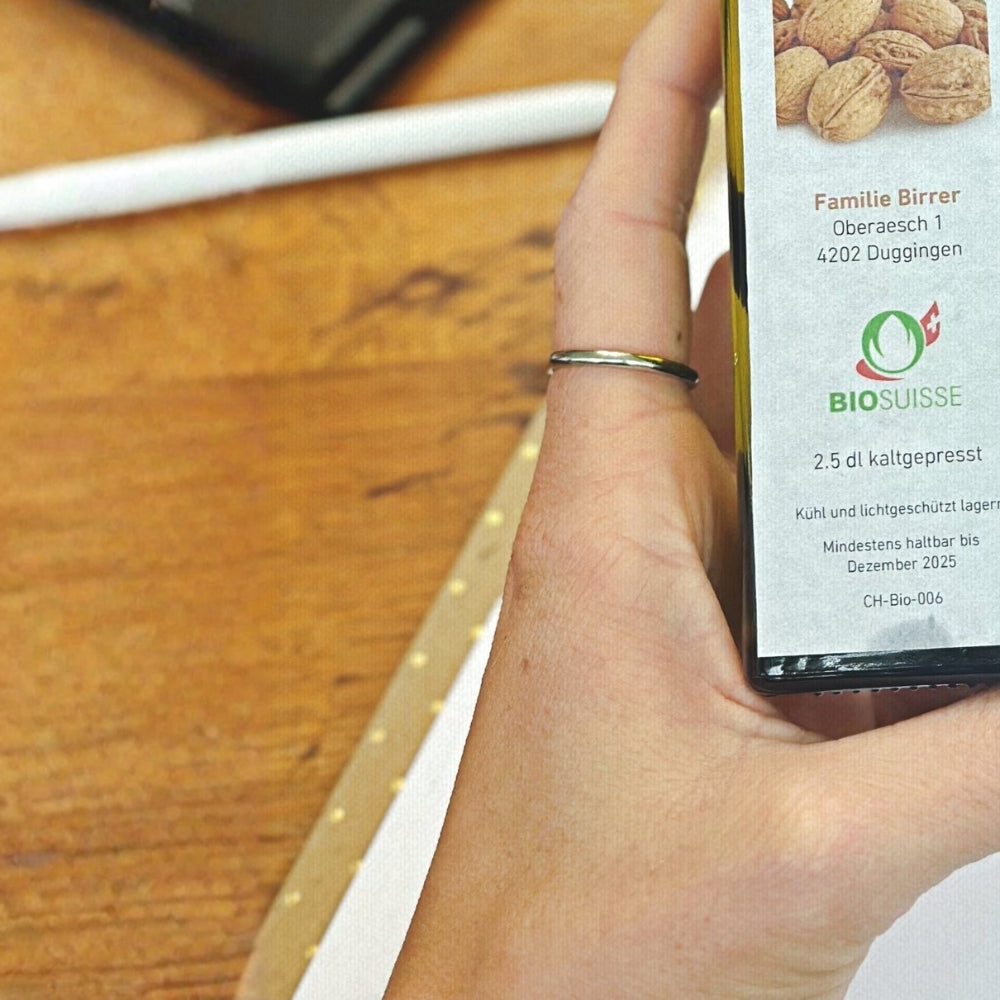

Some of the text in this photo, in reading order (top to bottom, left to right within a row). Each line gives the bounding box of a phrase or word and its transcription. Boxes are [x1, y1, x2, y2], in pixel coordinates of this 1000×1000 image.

[814, 188, 961, 210] Familie Birrer
[833, 214, 942, 236] Oberaesch 1
[817, 242, 962, 263] 4202 Duggingen
[814, 446, 983, 470] 2.5 dl kaltgepresst
[795, 506, 826, 520] Kühl
[830, 505, 856, 518] und
[860, 500, 957, 518] lichtgeschützt
[823, 533, 980, 553] Mindestens haltbar bis
[848, 555, 957, 573] Dezember 2025
[863, 591, 944, 608] CH-Bio-006
